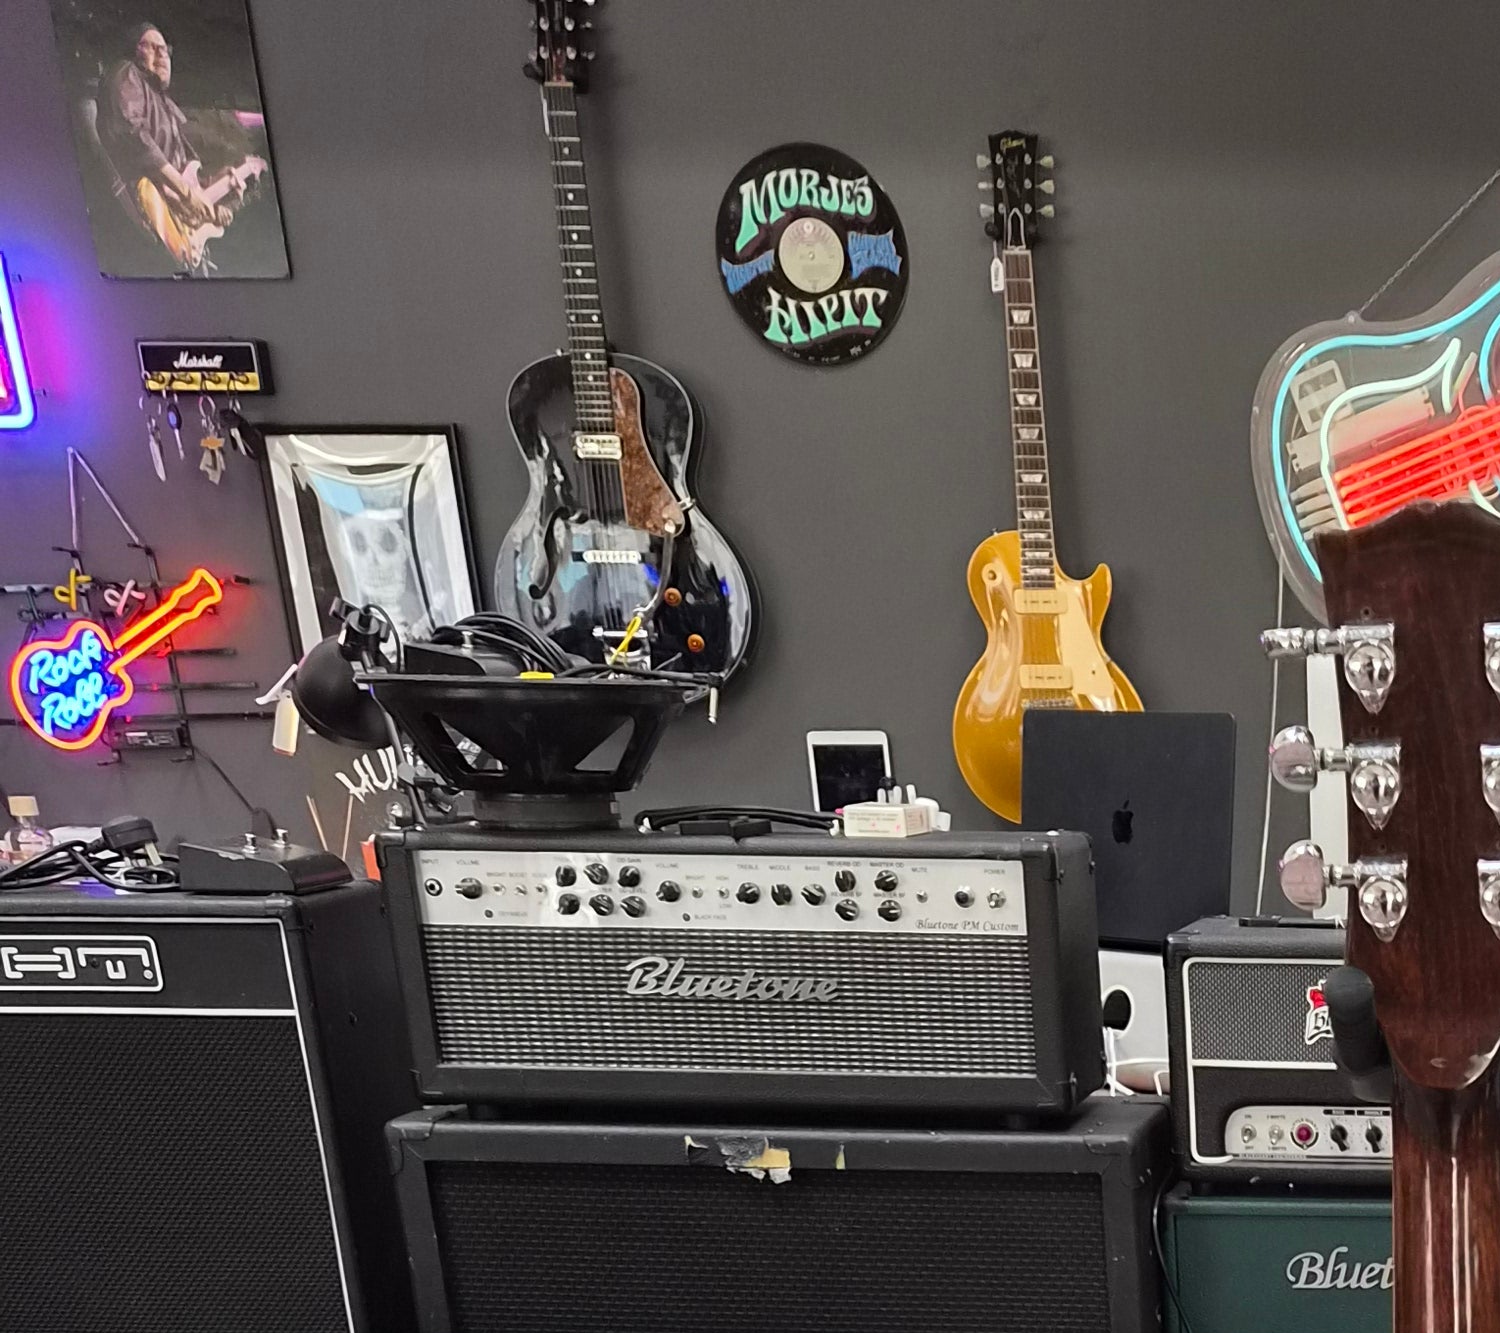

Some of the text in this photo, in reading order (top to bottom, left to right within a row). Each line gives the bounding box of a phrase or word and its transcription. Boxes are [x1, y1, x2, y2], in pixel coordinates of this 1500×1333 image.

[735, 167, 874, 254] MORJES
[173, 351, 224, 369] Marshall
[29, 629, 103, 694] Rock
[40, 672, 110, 735] Roll
[915, 918, 959, 931] Bluetone
[982, 920, 1019, 932] Custom
[625, 956, 839, 1001] Bluetone
[1286, 1246, 1395, 1290] Bluet
